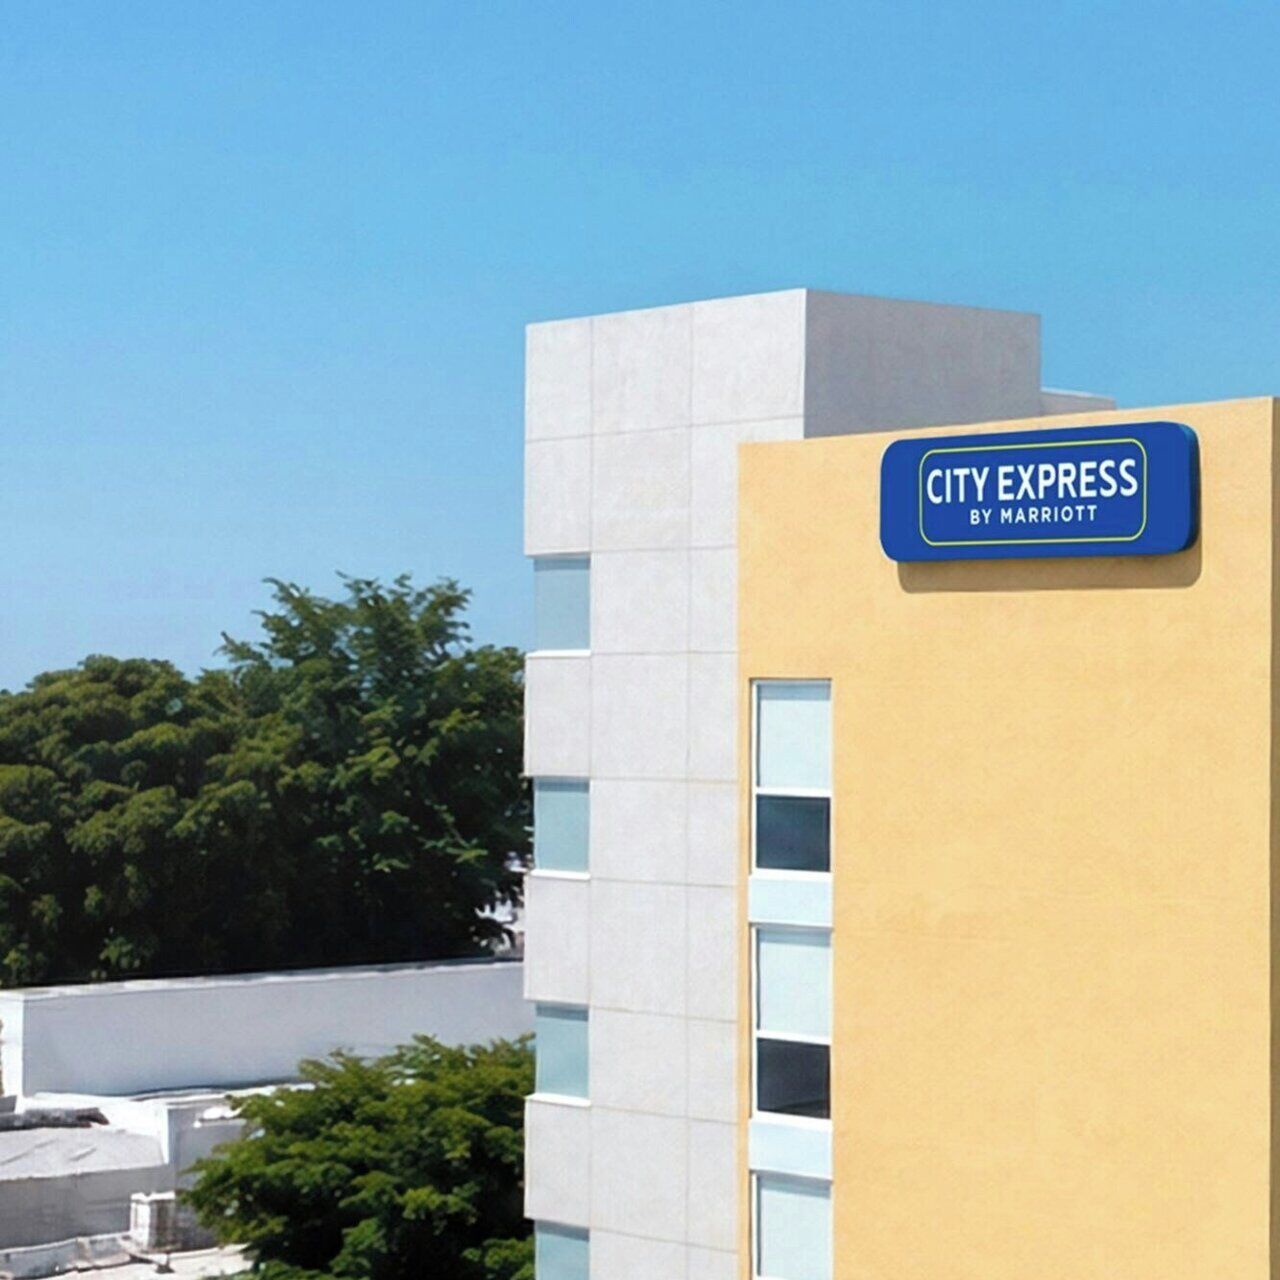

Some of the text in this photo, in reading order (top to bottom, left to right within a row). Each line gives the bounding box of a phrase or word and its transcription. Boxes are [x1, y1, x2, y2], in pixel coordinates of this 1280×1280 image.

[926, 458, 1138, 504] CITY EXPRESS
[970, 504, 1097, 525] BY MARRIOTT
